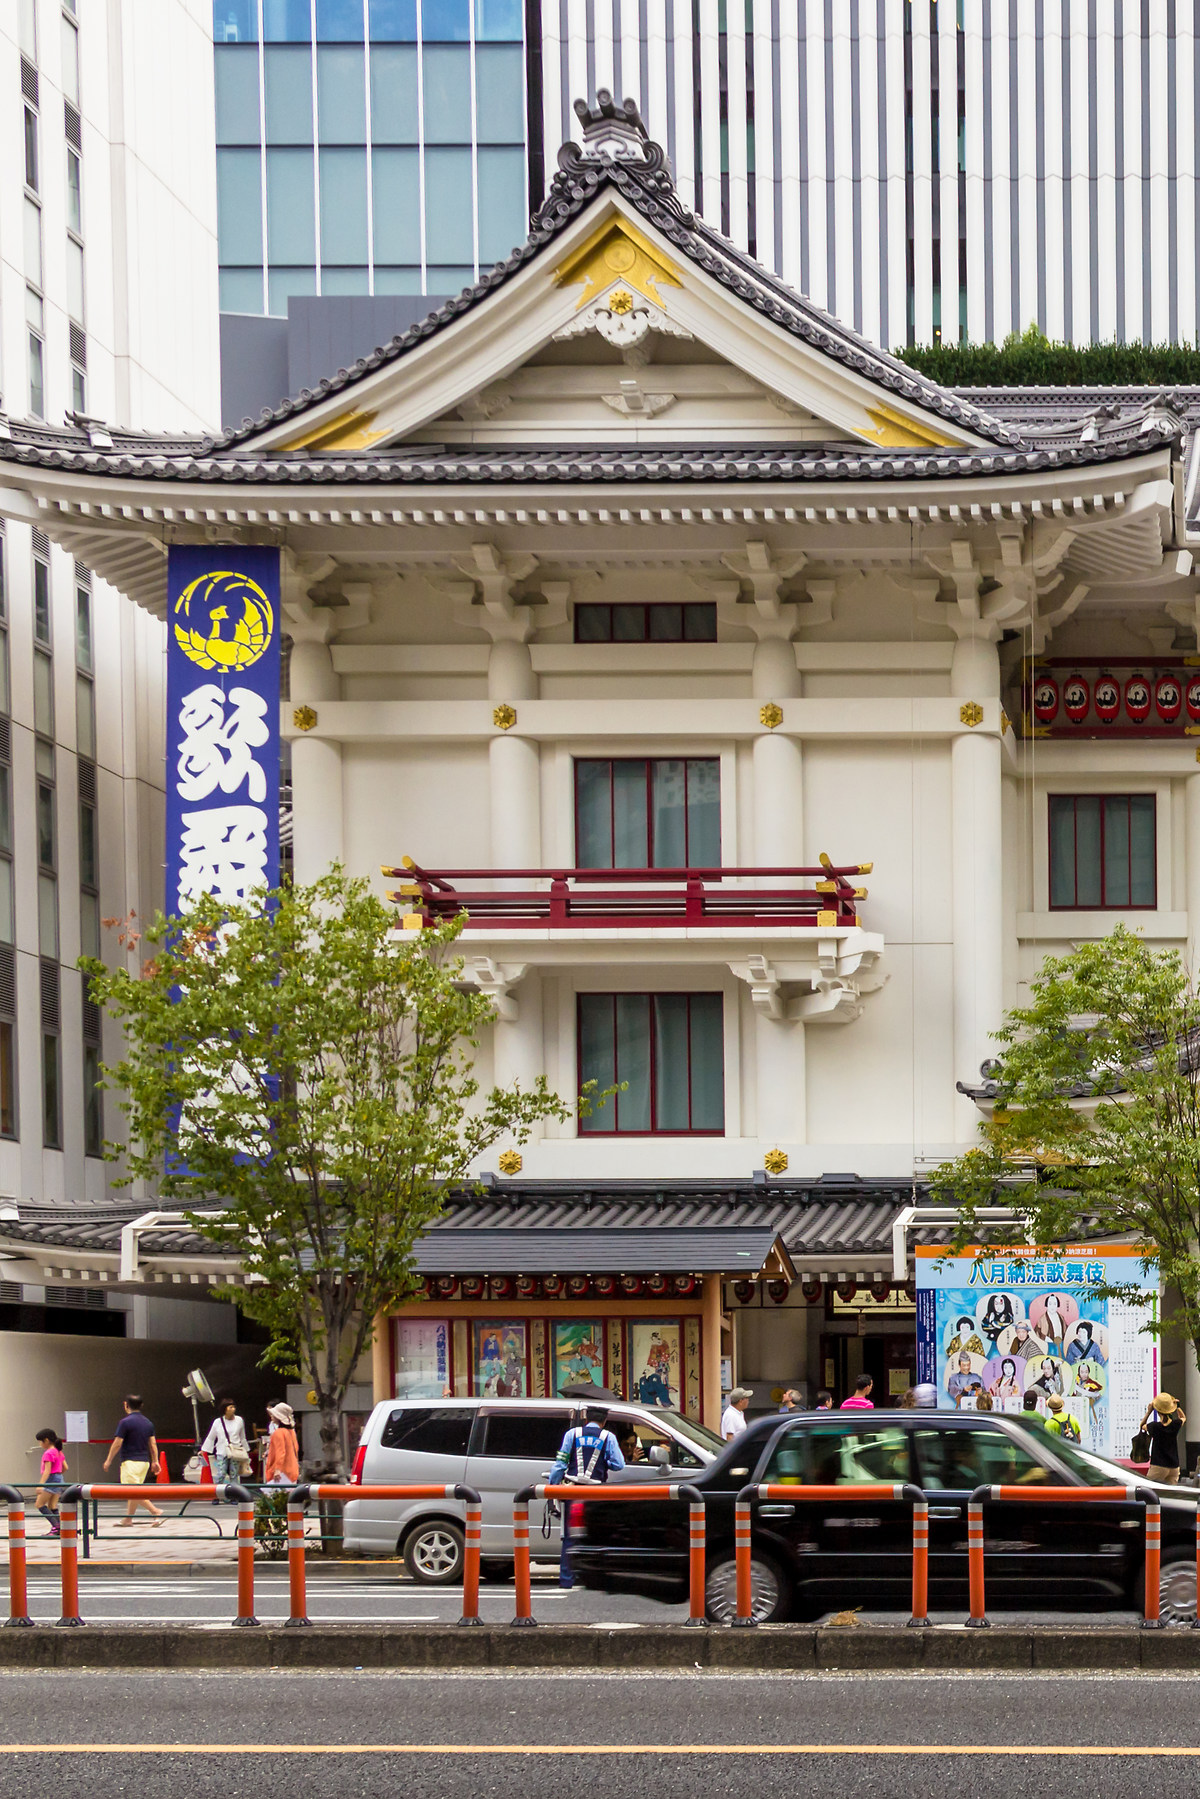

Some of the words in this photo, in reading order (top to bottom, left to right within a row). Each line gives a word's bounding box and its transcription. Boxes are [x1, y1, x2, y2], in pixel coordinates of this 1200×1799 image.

[970, 1262, 1105, 1285] 八月納涼歌舞伎
